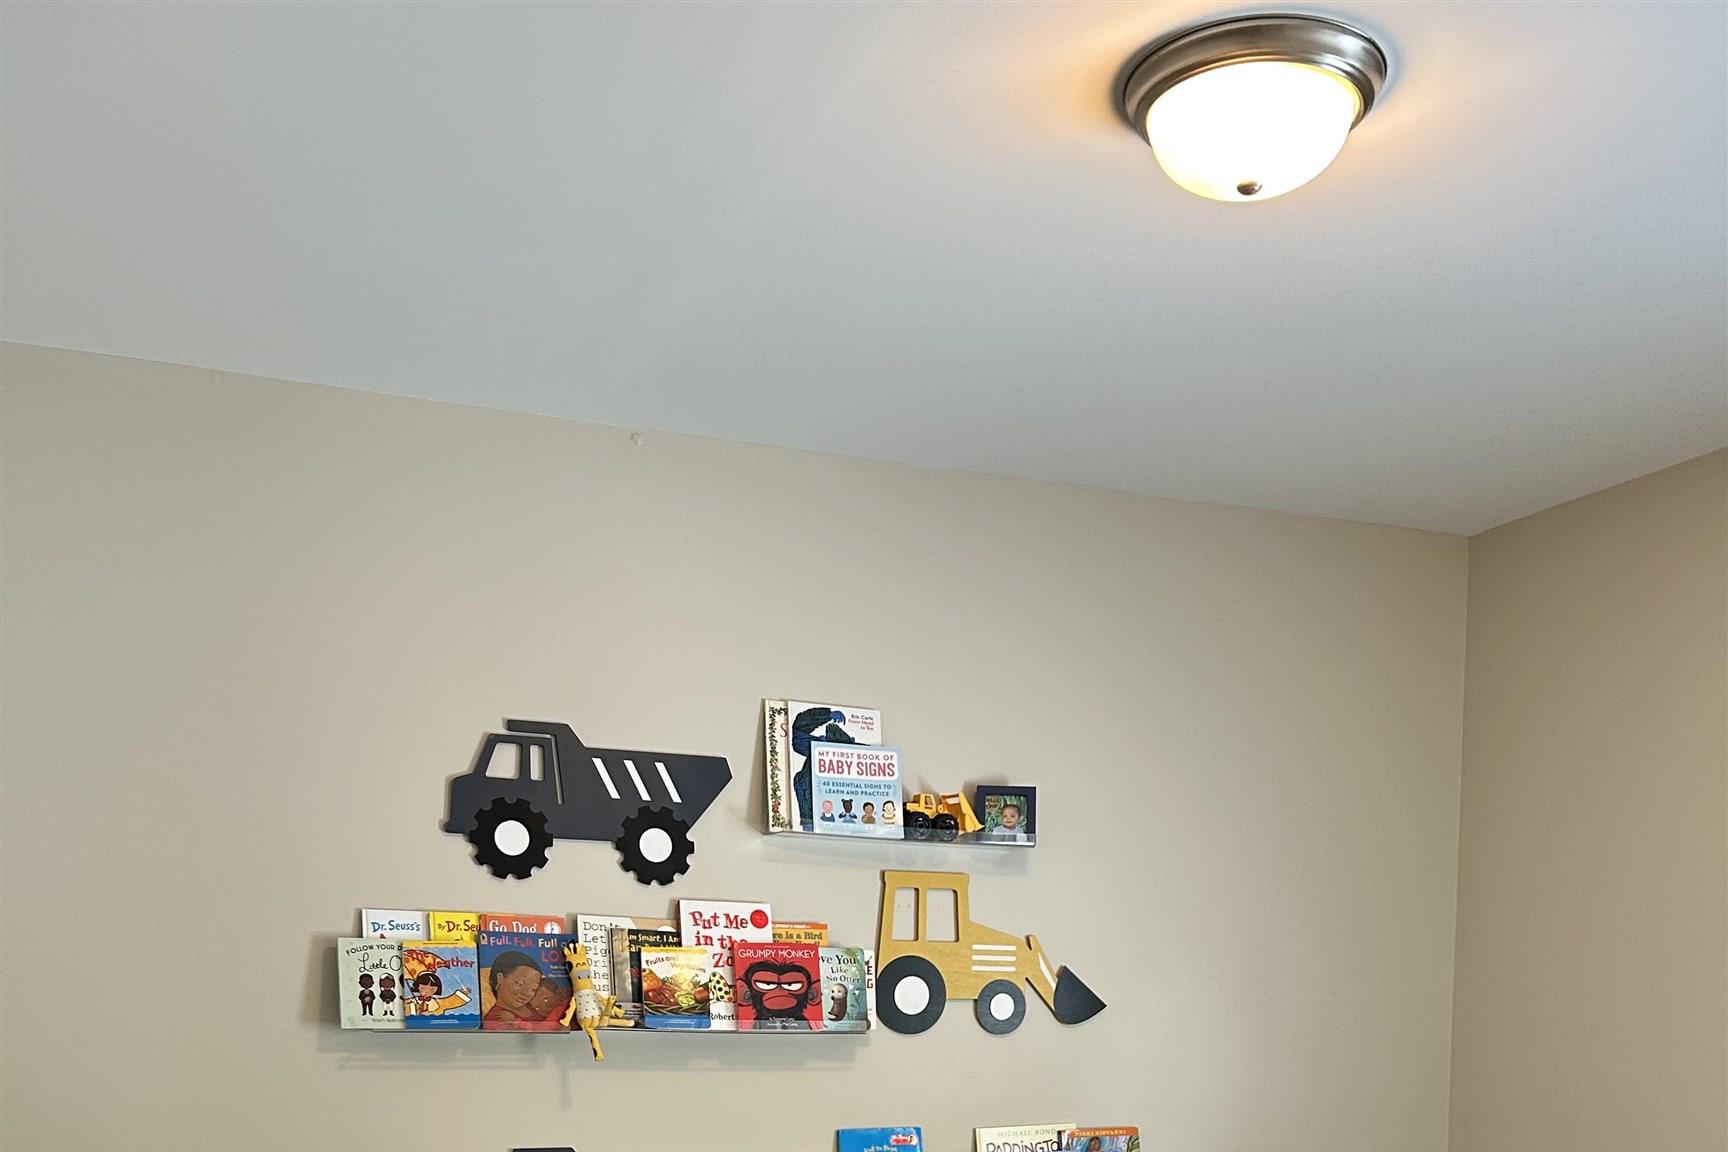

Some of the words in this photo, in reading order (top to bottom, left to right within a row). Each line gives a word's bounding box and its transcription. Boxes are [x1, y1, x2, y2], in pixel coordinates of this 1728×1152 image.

[857, 752, 880, 761] BOOK
[818, 759, 853, 775] BABY
[857, 761, 896, 777] SIGNS
[489, 920, 507, 932] Go
[689, 911, 720, 930] Put
[723, 913, 748, 930] Me
[371, 921, 387, 933] Dr.
[388, 920, 421, 932] Seuss's
[446, 920, 463, 933] Dr.
[584, 933, 607, 944] Let
[695, 931, 714, 946] in
[785, 930, 794, 940] Is
[804, 931, 823, 940] Bird
[538, 938, 557, 948] Full
[346, 944, 374, 956] FOLLOW
[738, 949, 776, 959] GRUMPY
[778, 949, 816, 960] MONKEY
[358, 952, 388, 973] Little
[645, 957, 664, 967] Fruits
[836, 955, 856, 965] You
[830, 966, 849, 974] Like
[826, 975, 838, 983] No
[840, 974, 861, 984] Otter
[710, 1012, 735, 1022] Robert
[998, 1129, 1031, 1138] MICHAEL
